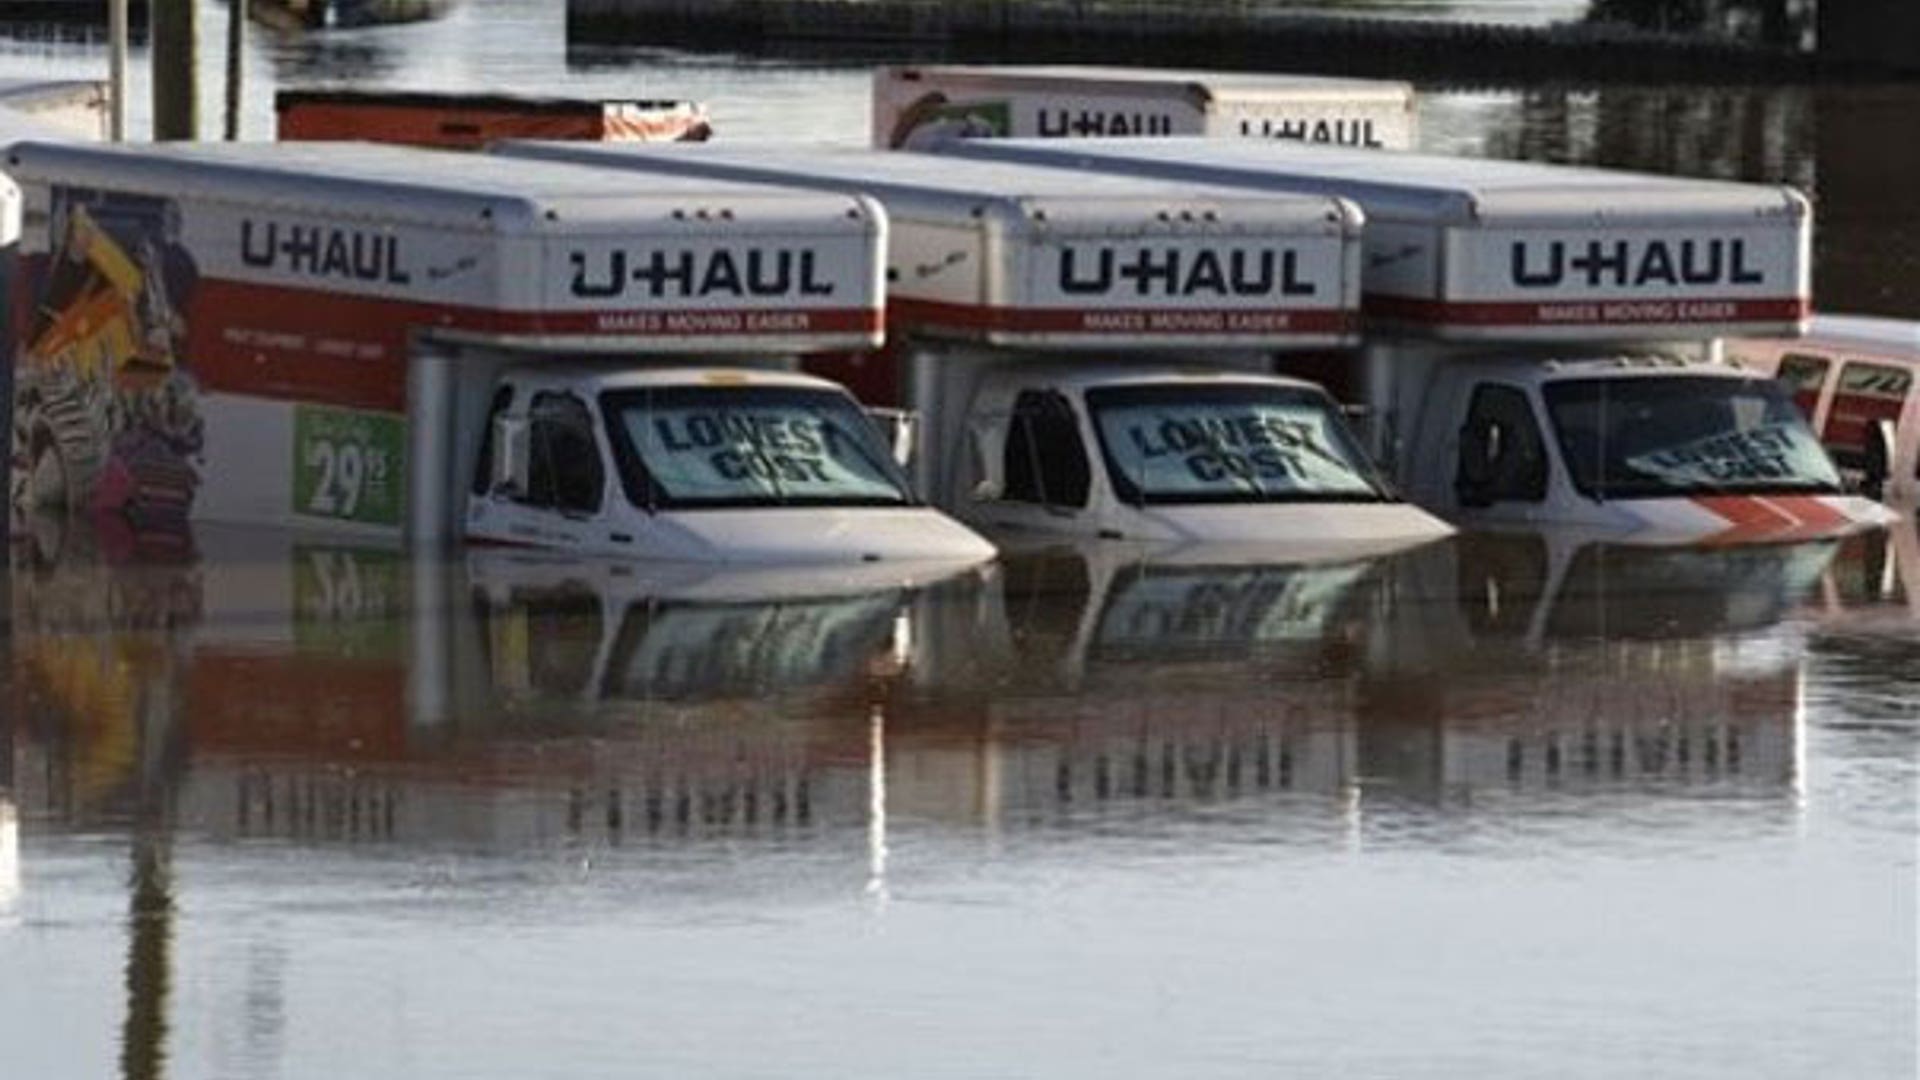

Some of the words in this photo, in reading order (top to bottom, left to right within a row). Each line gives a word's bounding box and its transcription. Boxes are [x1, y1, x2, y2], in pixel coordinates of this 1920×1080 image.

[1037, 109, 1171, 137] U-HAUL
[241, 219, 411, 285] U-HAUL
[1059, 247, 1315, 295] U-HAUL
[1511, 238, 1763, 287] U-HAUL
[570, 249, 835, 298] U-HAUL
[598, 313, 661, 331] MAKES
[667, 312, 742, 331] MOVING
[747, 312, 810, 331] EASIER
[1084, 312, 1145, 330] MAKES
[1150, 312, 1224, 330] MOVING
[1227, 312, 1290, 330] EASIER
[1538, 303, 1598, 321] MAKES
[1603, 302, 1673, 320] MOVING
[1678, 301, 1738, 319] EASIER
[654, 412, 841, 454] LOWEST
[1129, 415, 1316, 458] LOWEST
[305, 439, 361, 516] 29
[712, 450, 832, 483] COST
[1186, 449, 1308, 482] COST
